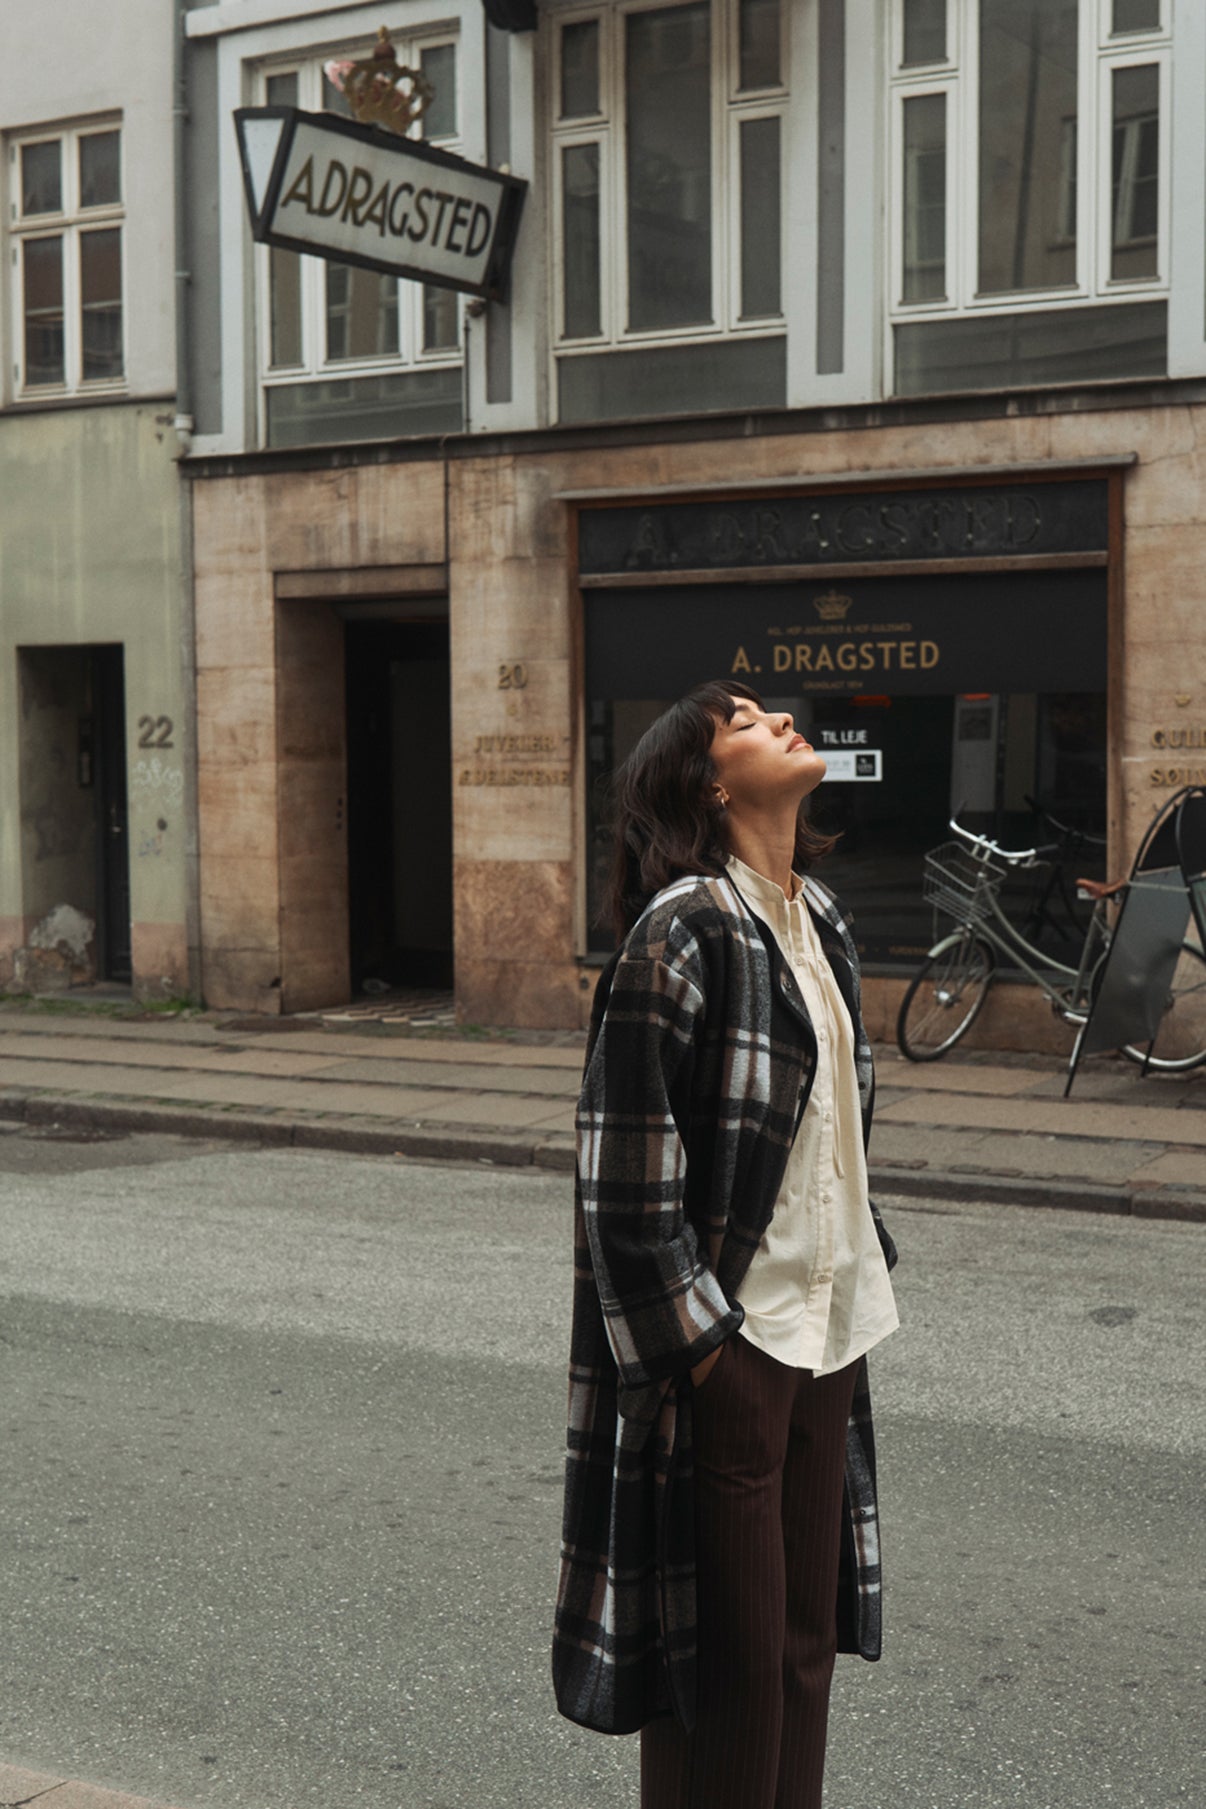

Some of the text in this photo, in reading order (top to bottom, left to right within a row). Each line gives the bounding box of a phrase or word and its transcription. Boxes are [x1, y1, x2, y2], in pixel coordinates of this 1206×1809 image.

[731, 640, 940, 673] A. DRAGSTED
[498, 664, 527, 690] 20
[137, 714, 174, 749] 22
[820, 729, 868, 744] TIL LEJE
